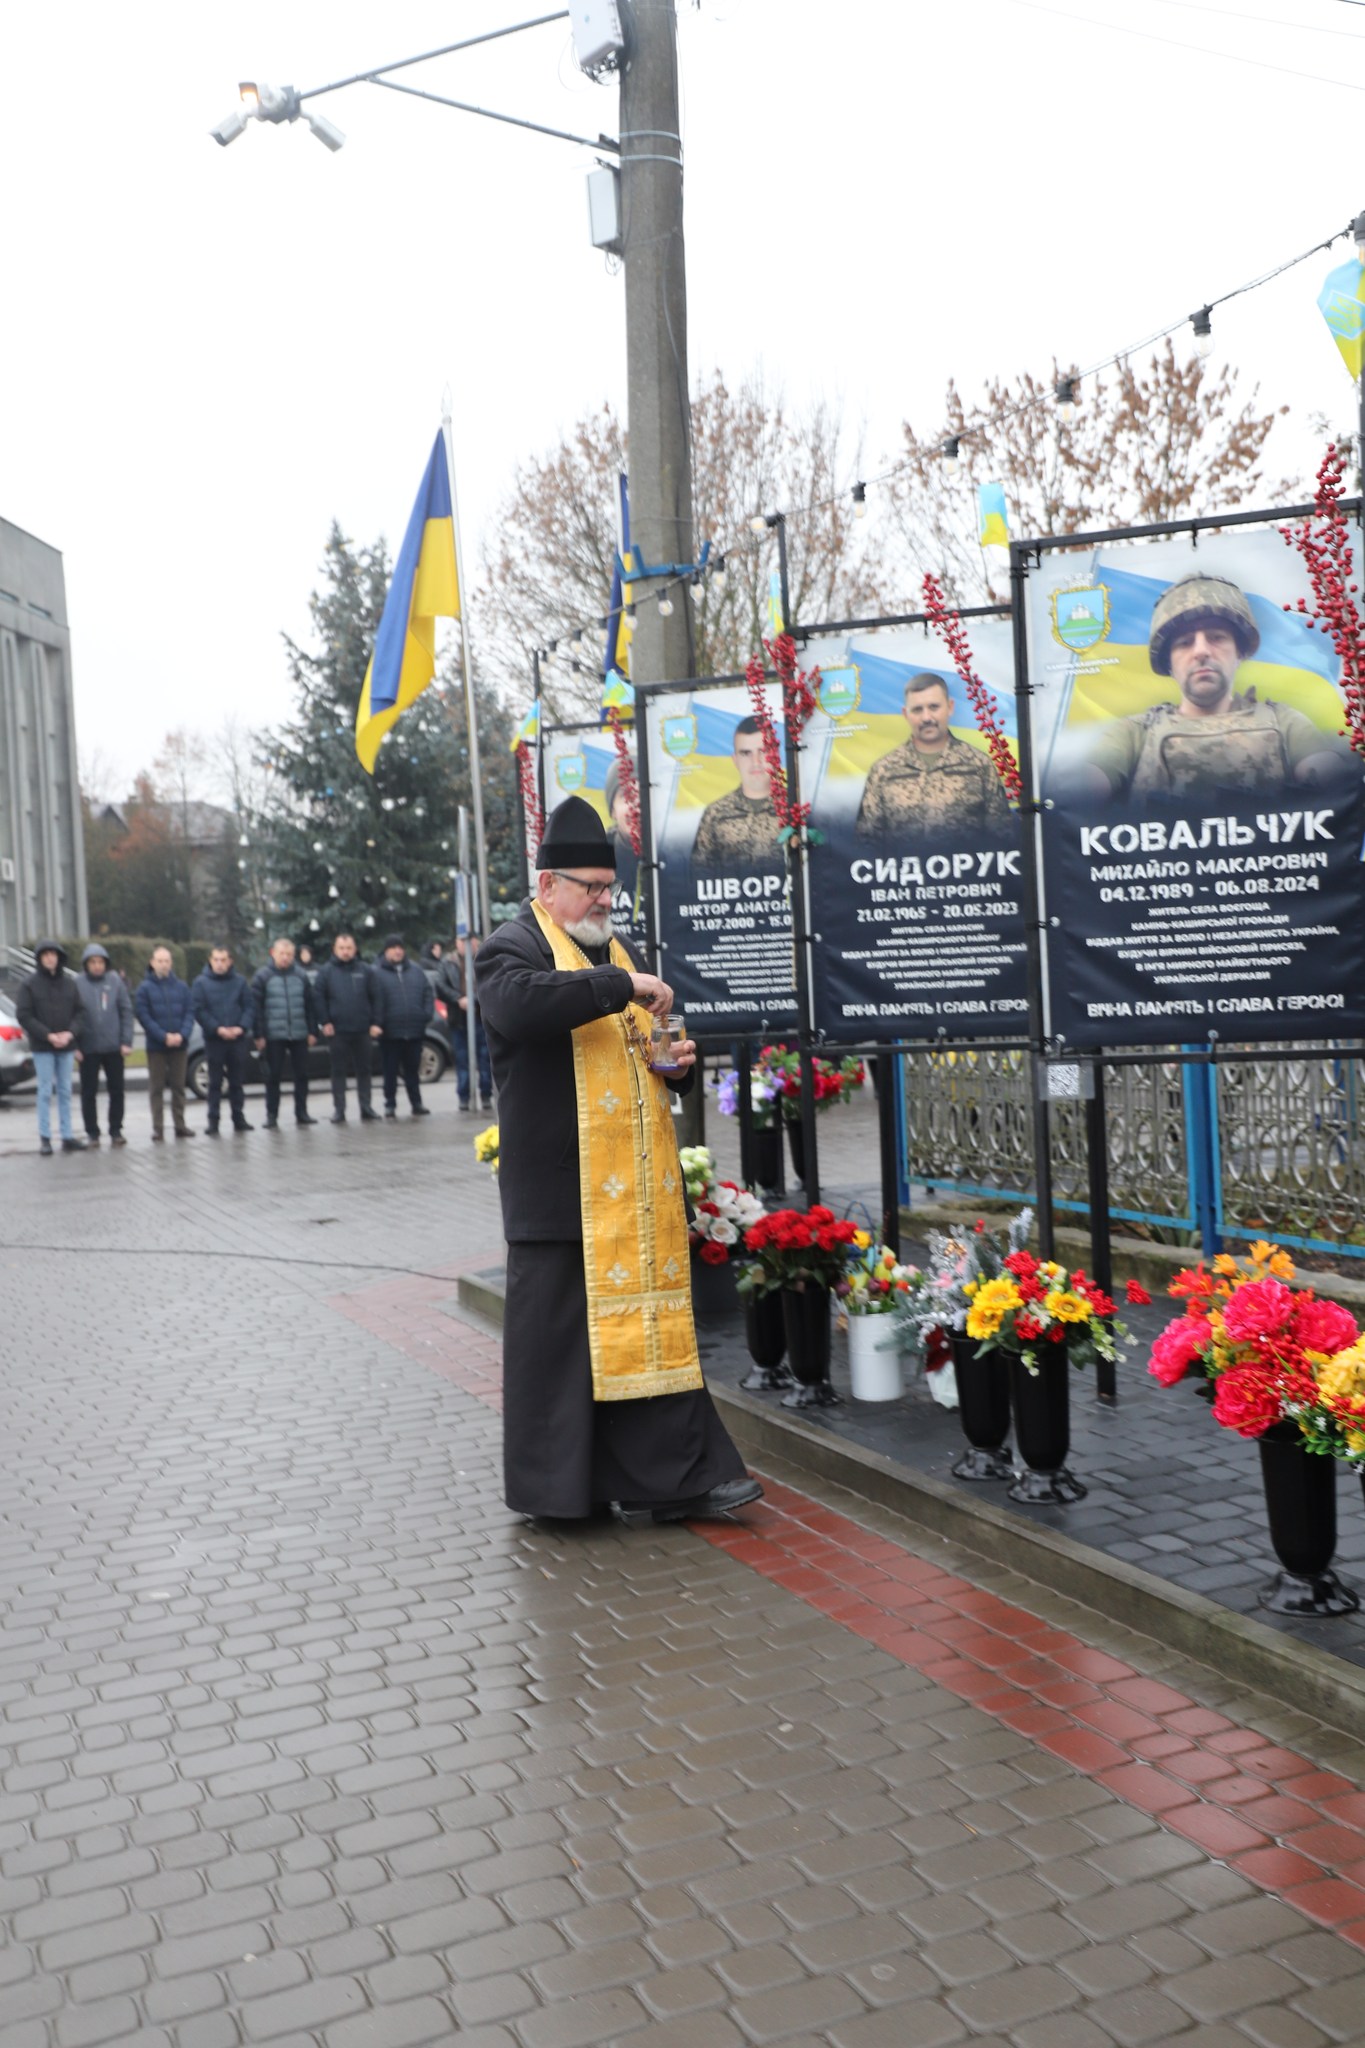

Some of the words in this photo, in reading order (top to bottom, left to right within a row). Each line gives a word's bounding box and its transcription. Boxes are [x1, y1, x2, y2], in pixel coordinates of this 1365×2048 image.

[1080, 809, 1335, 856] КОВАЛЬЧУК
[850, 850, 1022, 886] СИДОРУК
[1090, 859, 1190, 882] МИХАЙЛО
[1196, 852, 1328, 876] МАКАРОВИЧ
[871, 887, 910, 902] ІВАН
[915, 882, 1002, 900] ПЕТРОВИЧ
[1100, 883, 1194, 902] 04.12.1989
[1215, 875, 1319, 896] 06.08.2024
[679, 902, 730, 917] ВІКТОР
[734, 899, 791, 914] АНАТОЛ
[857, 906, 927, 922] 21.02.1965
[943, 902, 1019, 919] 20.05.2023
[1148, 907, 1190, 917] ЖИТЕЛЬ
[1190, 904, 1218, 914] СЕЛА
[1238, 914, 1290, 926] ГРОМАДИ
[1159, 934, 1174, 943] ЗА
[1174, 932, 1205, 942] ВОЛЮ
[942, 1000, 988, 1013] СЛАВА
[1087, 1001, 1133, 1018] ВІЧНА
[1207, 999, 1214, 1013] І
[1216, 996, 1274, 1013] СЛАВА
[1277, 994, 1345, 1011] ГЕРОЮ!
